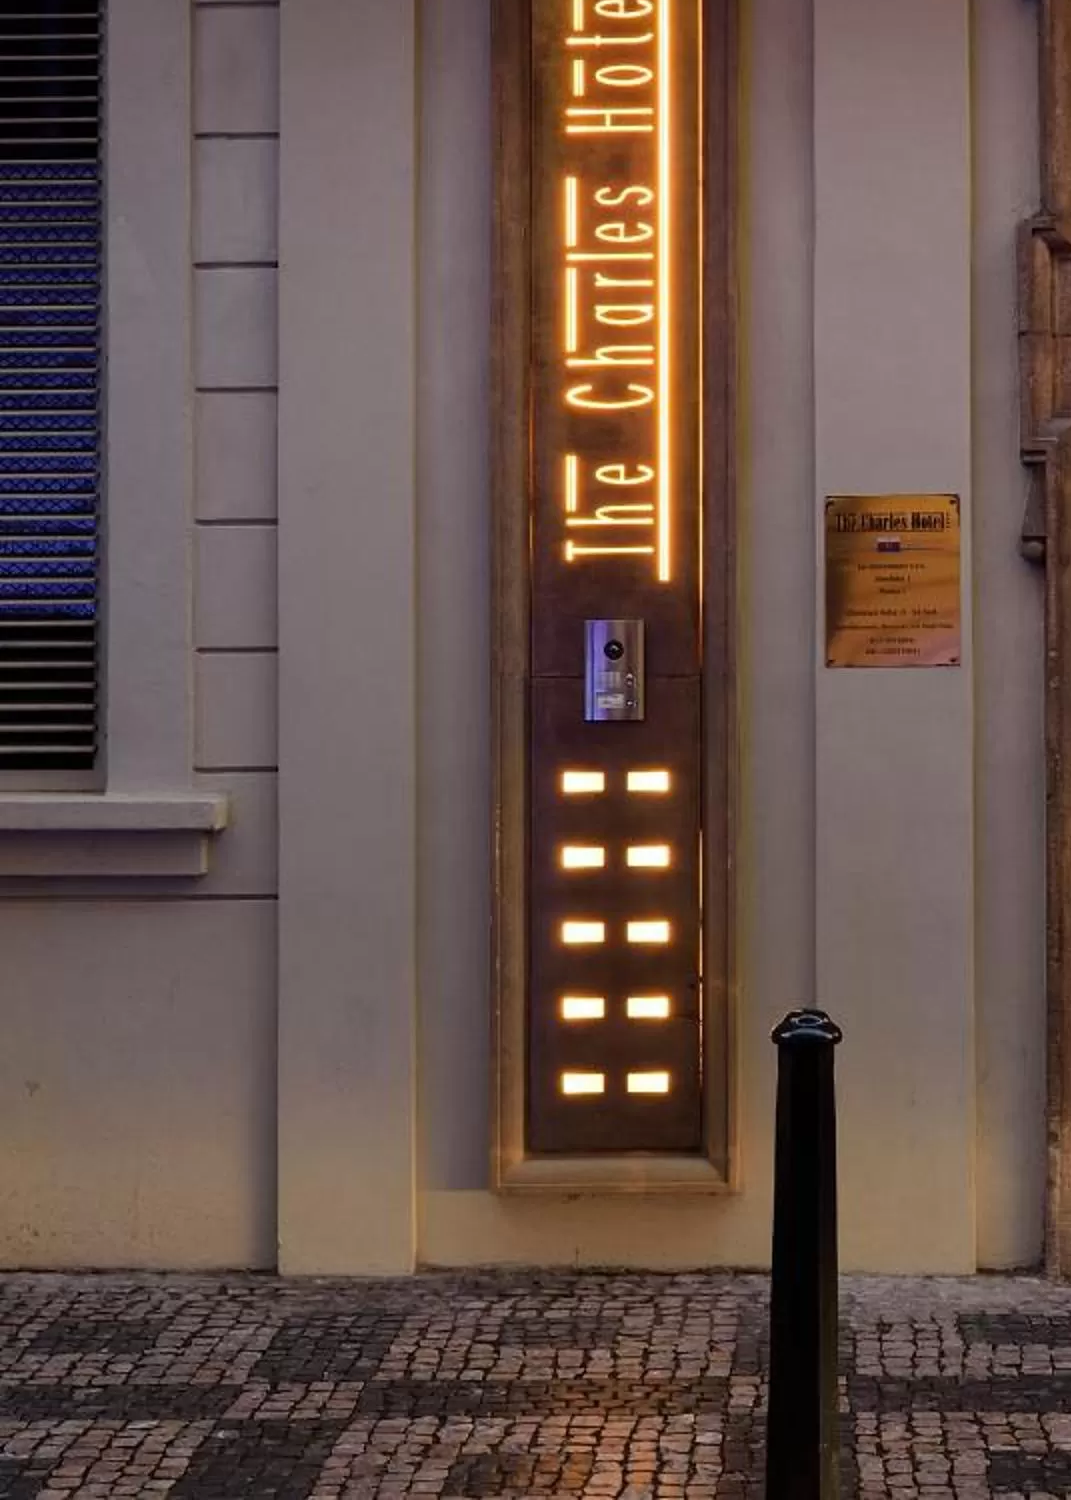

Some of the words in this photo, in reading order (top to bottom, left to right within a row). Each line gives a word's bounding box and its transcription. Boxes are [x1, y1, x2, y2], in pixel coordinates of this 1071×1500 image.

[565, 185, 655, 409] Charles
[565, 461, 654, 563] The
[861, 512, 910, 531] Charles
[911, 511, 945, 530] Hotel
